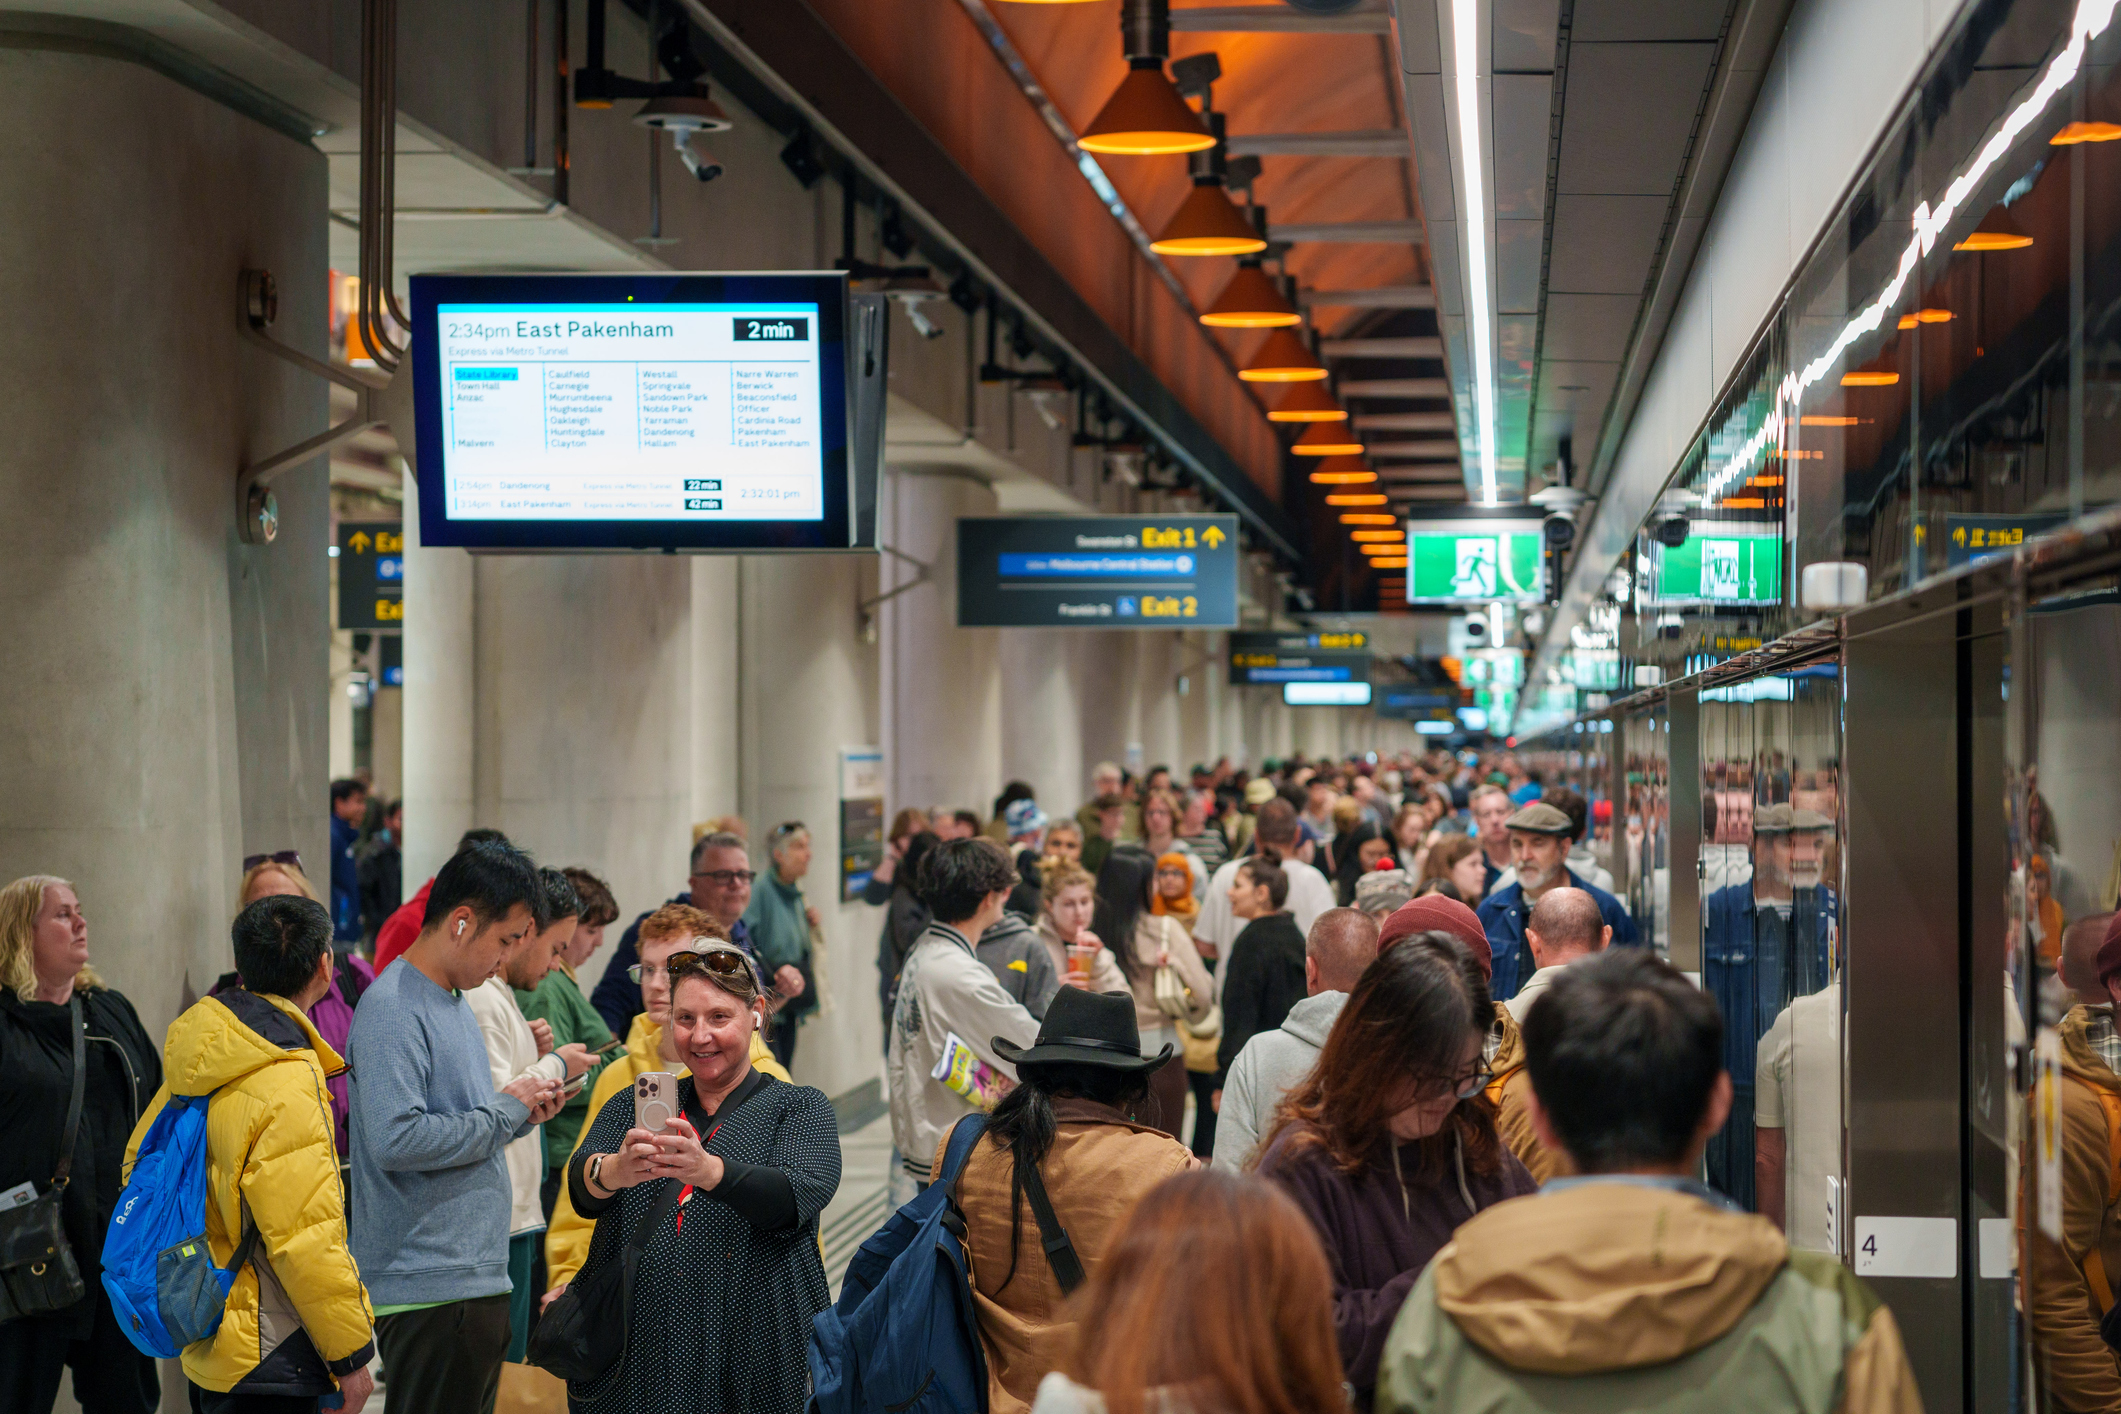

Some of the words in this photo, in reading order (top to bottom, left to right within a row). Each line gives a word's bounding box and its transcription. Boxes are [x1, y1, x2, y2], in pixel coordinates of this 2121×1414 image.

[449, 323, 510, 341] 2:34pm
[517, 321, 562, 338] East
[568, 320, 673, 338] Pakenham
[748, 321, 761, 339] 2
[762, 321, 795, 339] min
[448, 347, 488, 357] Express
[491, 347, 504, 356] via
[506, 347, 535, 356] Metro
[538, 346, 569, 356] Tunnel
[456, 370, 482, 379] State
[484, 370, 517, 381] Library
[548, 370, 590, 379] Caulfield
[642, 370, 678, 378] Westall
[736, 370, 762, 378] Narre
[765, 370, 799, 378] Warren
[456, 382, 480, 390] Town
[482, 382, 500, 390] Hall
[549, 382, 590, 391] Carnegie
[642, 382, 691, 391] Springvale
[737, 382, 774, 390] Berwick
[456, 393, 484, 401] Anzac
[549, 393, 613, 401] Murrumbeena
[643, 393, 685, 401] Sandown
[687, 393, 708, 401] Park
[737, 393, 797, 401] Beaconsfield
[550, 405, 603, 414] Hughesdale
[643, 405, 669, 413] Noble
[671, 405, 693, 413] Park
[737, 405, 770, 413] Officer
[550, 417, 590, 426] Oakleigh
[737, 416, 776, 424] Cardinia
[778, 416, 801, 424] Road
[550, 428, 605, 437] Huntingdale
[643, 428, 695, 437] Dandenong
[738, 428, 786, 436] Pakenham
[458, 439, 495, 447] Malvern
[551, 439, 587, 448] Clayton
[644, 439, 677, 447] Hallam
[738, 439, 759, 447] East
[761, 439, 810, 447] Pakenham
[499, 481, 551, 491] Dandenong
[687, 480, 701, 490] 22
[701, 480, 718, 490] min
[741, 489, 780, 498] 2:32:01
[783, 489, 800, 500] pm
[688, 500, 701, 510] 42
[701, 500, 718, 510] min
[1142, 527, 1183, 548] Exit
[1184, 527, 1198, 548] 1
[1141, 596, 1181, 617] Exit
[1182, 596, 1198, 617] 2
[1861, 1234, 1878, 1257] 4
